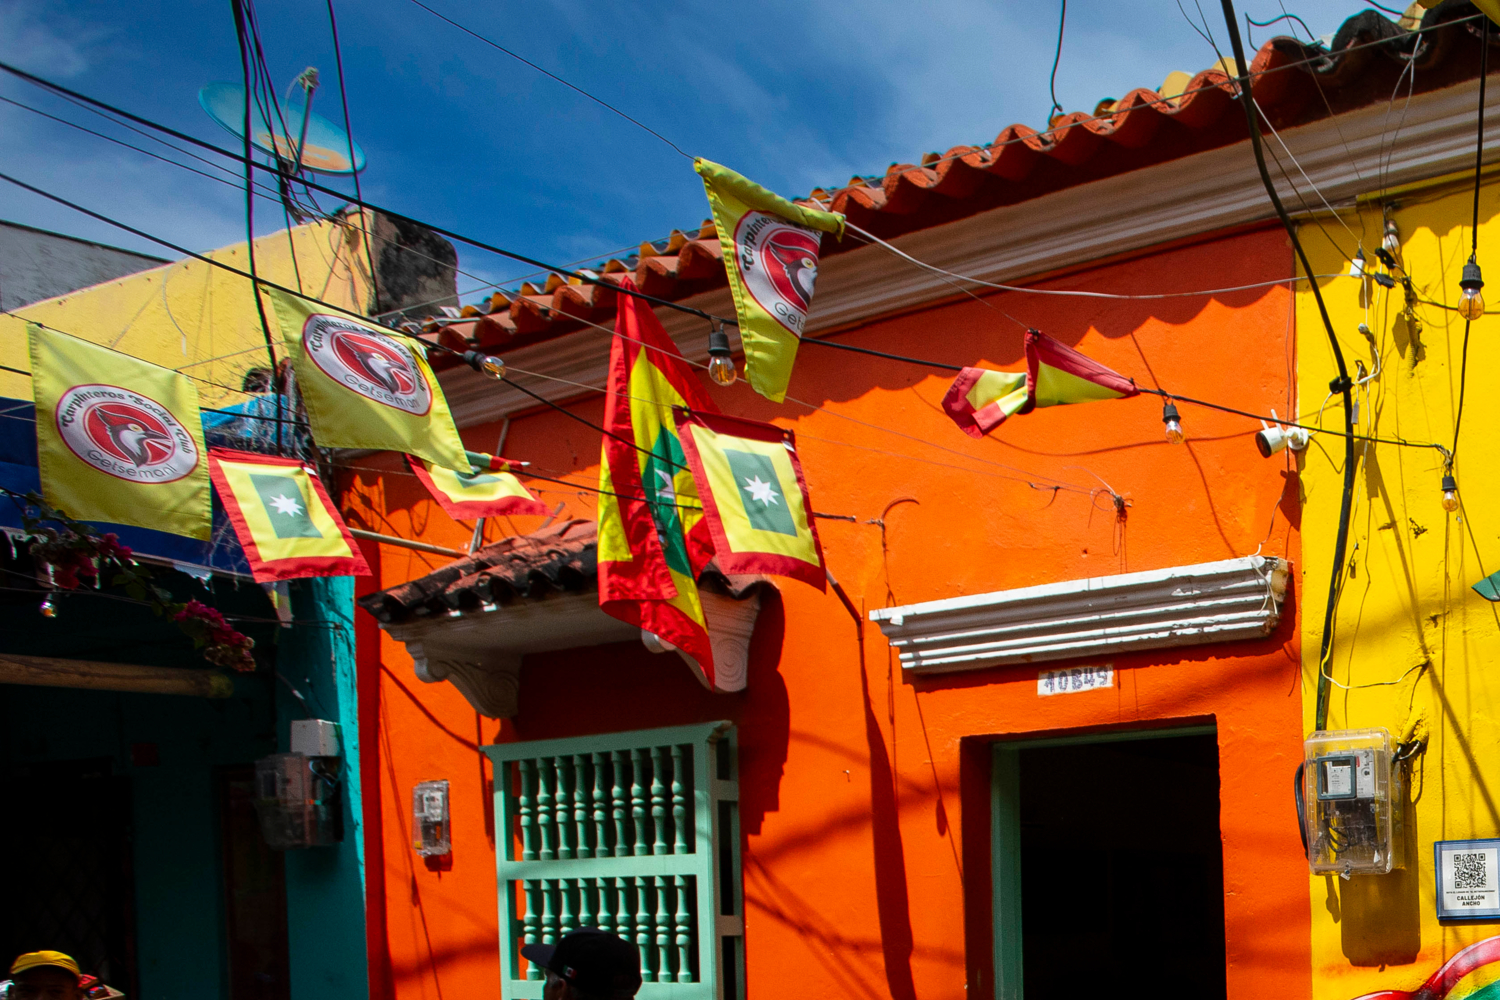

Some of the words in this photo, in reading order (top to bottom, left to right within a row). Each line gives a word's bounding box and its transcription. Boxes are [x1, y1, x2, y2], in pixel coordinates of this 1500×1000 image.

[58, 390, 125, 428] Carpinteros
[127, 394, 178, 427] Social
[173, 428, 194, 454] Club
[87, 450, 177, 479] Getsemani
